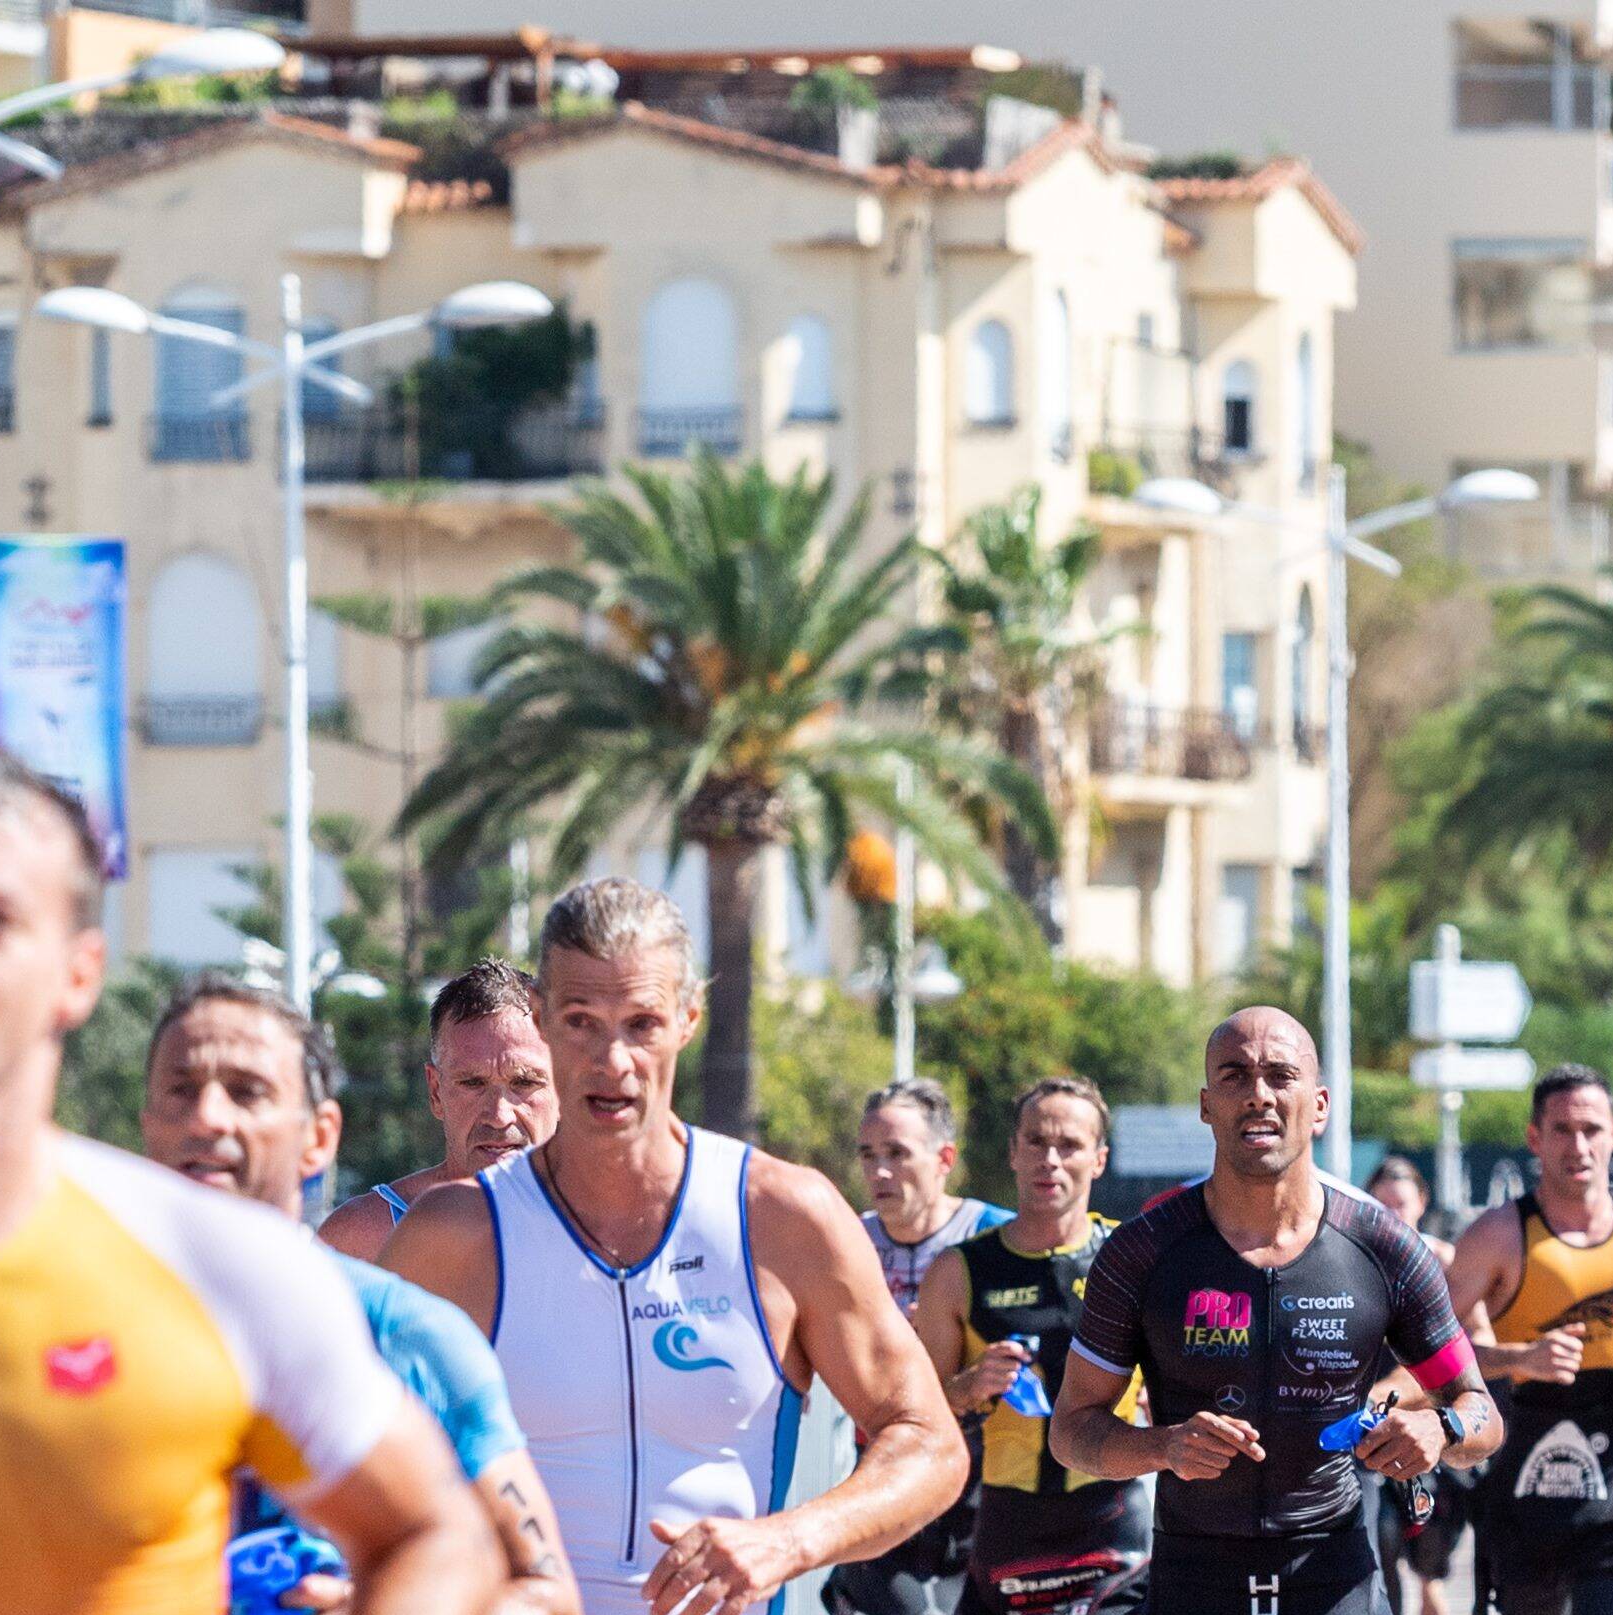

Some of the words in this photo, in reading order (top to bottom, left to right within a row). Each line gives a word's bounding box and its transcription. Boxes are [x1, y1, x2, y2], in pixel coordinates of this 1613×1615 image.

[1184, 1288, 1252, 1330] PRO
[1299, 1317, 1347, 1329] SWEET
[1183, 1326, 1250, 1346] TEAM
[1182, 1344, 1250, 1358] SPORTS
[1295, 1347, 1353, 1360] Mandelieu
[1318, 1359, 1360, 1369] Napoule
